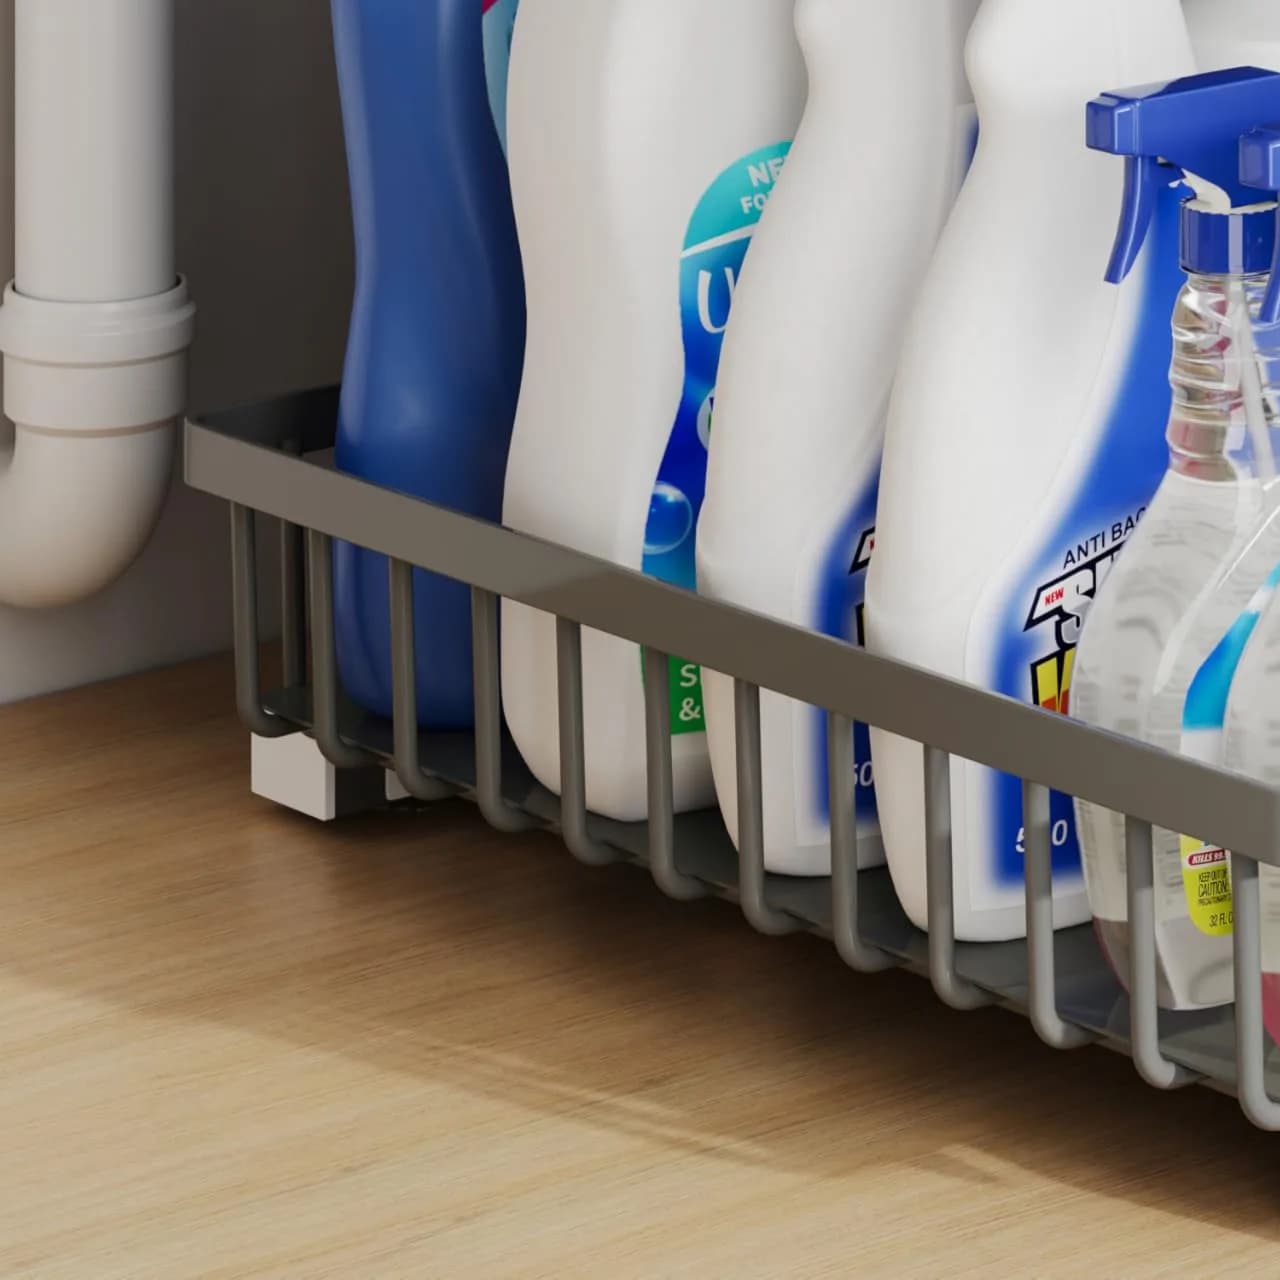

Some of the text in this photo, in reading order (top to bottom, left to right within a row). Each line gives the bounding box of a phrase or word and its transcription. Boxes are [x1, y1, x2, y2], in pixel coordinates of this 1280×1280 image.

[747, 154, 786, 188] NE
[740, 191, 771, 214] FO
[1063, 531, 1105, 570] ANTI
[1045, 587, 1064, 607] NEW
[1199, 880, 1227, 898] CAUTION
[1208, 914, 1218, 928] 32
